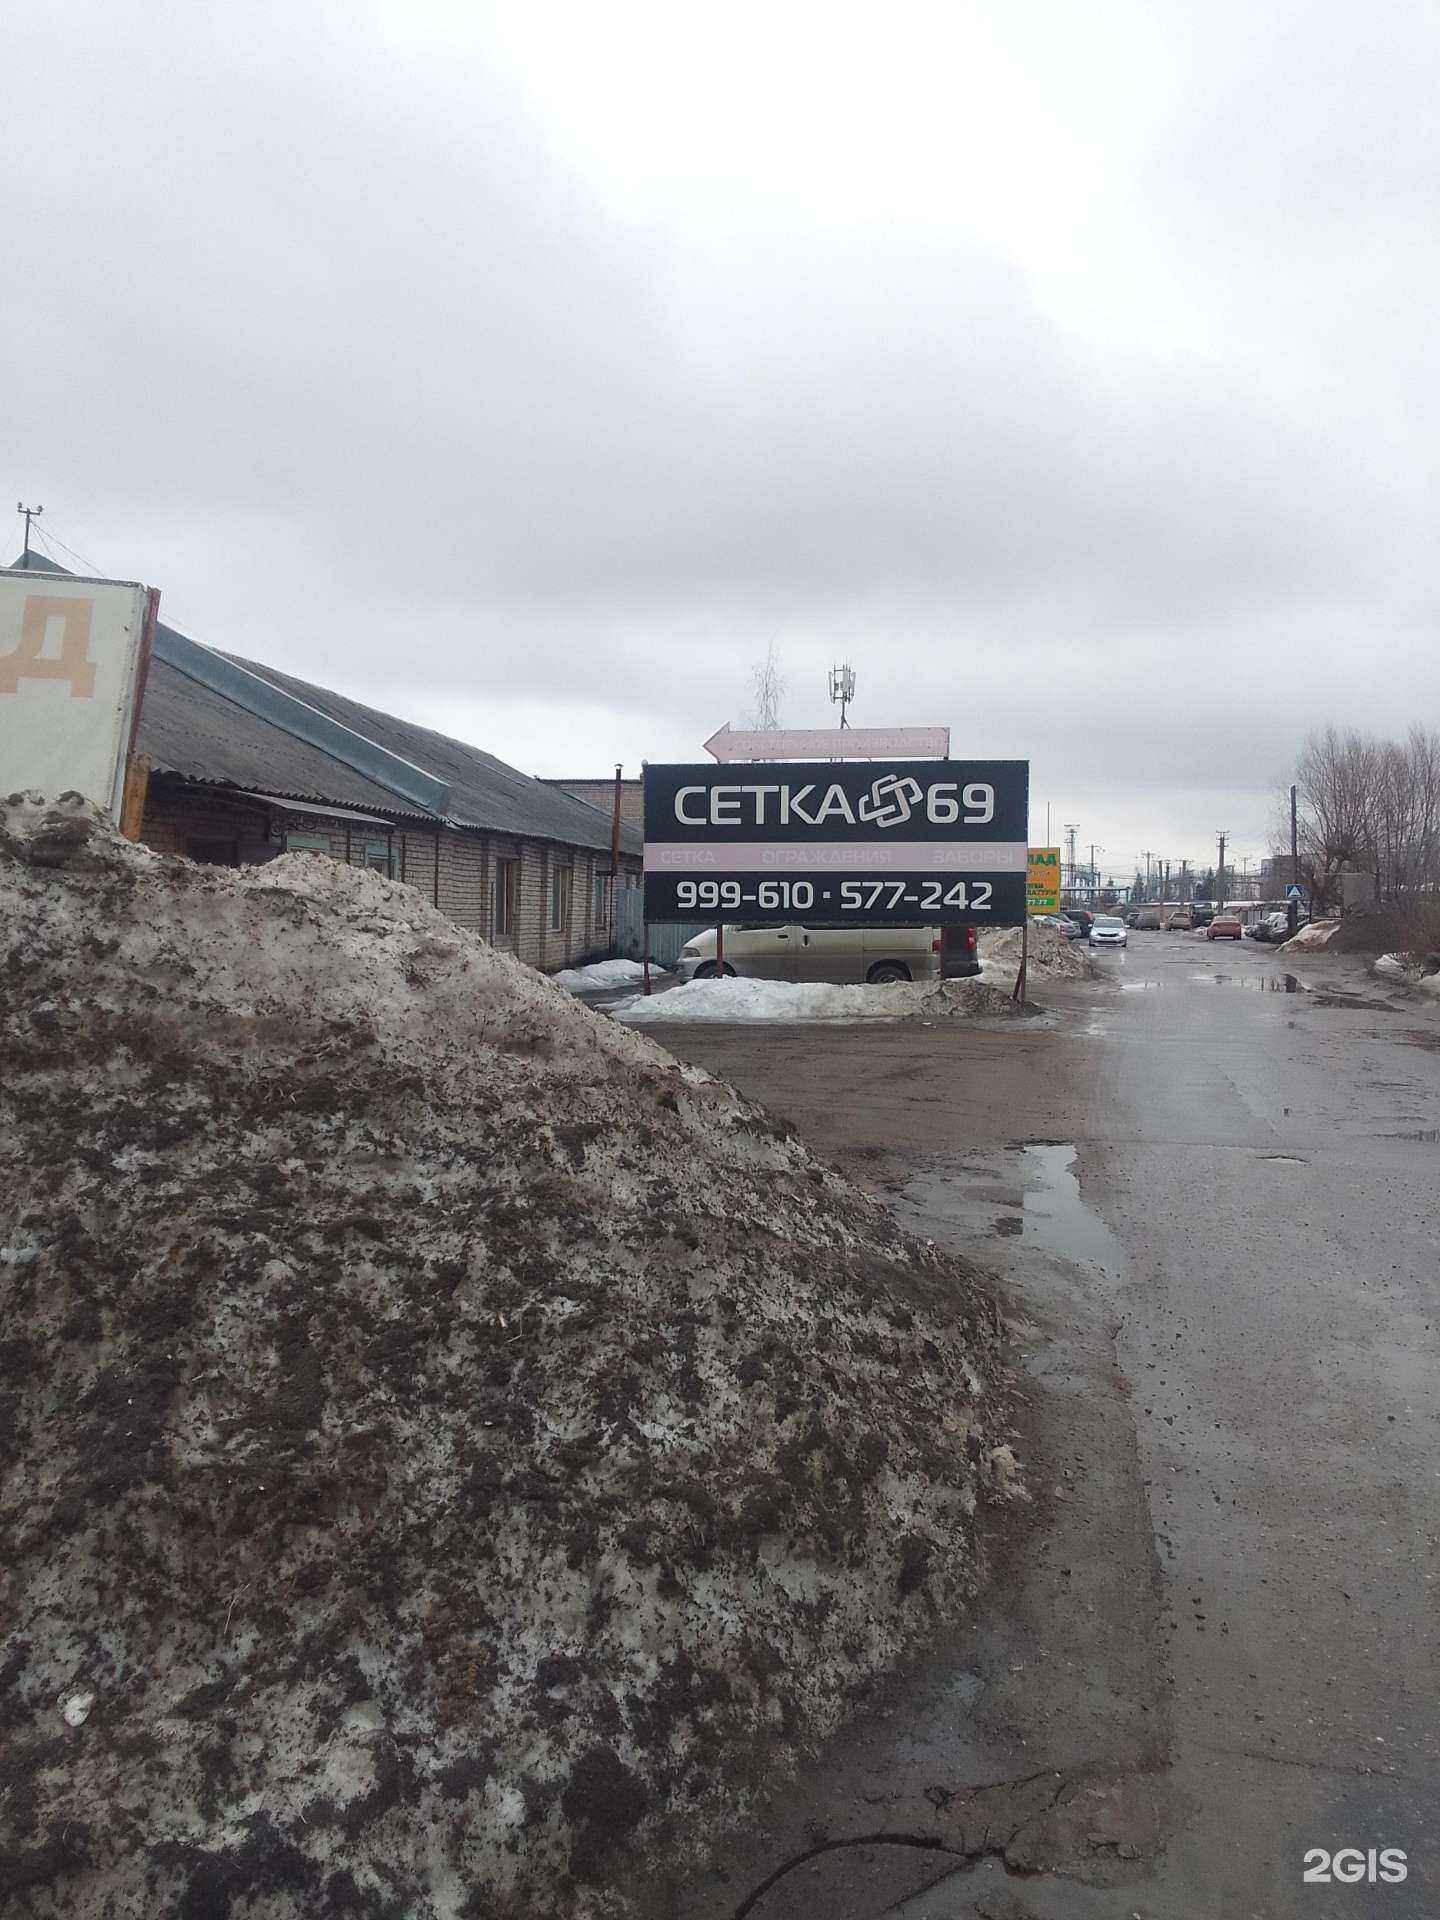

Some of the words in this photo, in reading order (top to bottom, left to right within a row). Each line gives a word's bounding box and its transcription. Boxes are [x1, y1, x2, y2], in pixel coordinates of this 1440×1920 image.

[674, 784, 857, 825] СЕТКА
[926, 783, 995, 824] 69
[660, 850, 717, 864] СЕТКА
[761, 850, 892, 864] ОГРАЖДЕНИЯ
[932, 850, 1014, 864] ЗАБОРЫ
[676, 881, 814, 909] 999-610
[840, 881, 993, 910] 577-242
